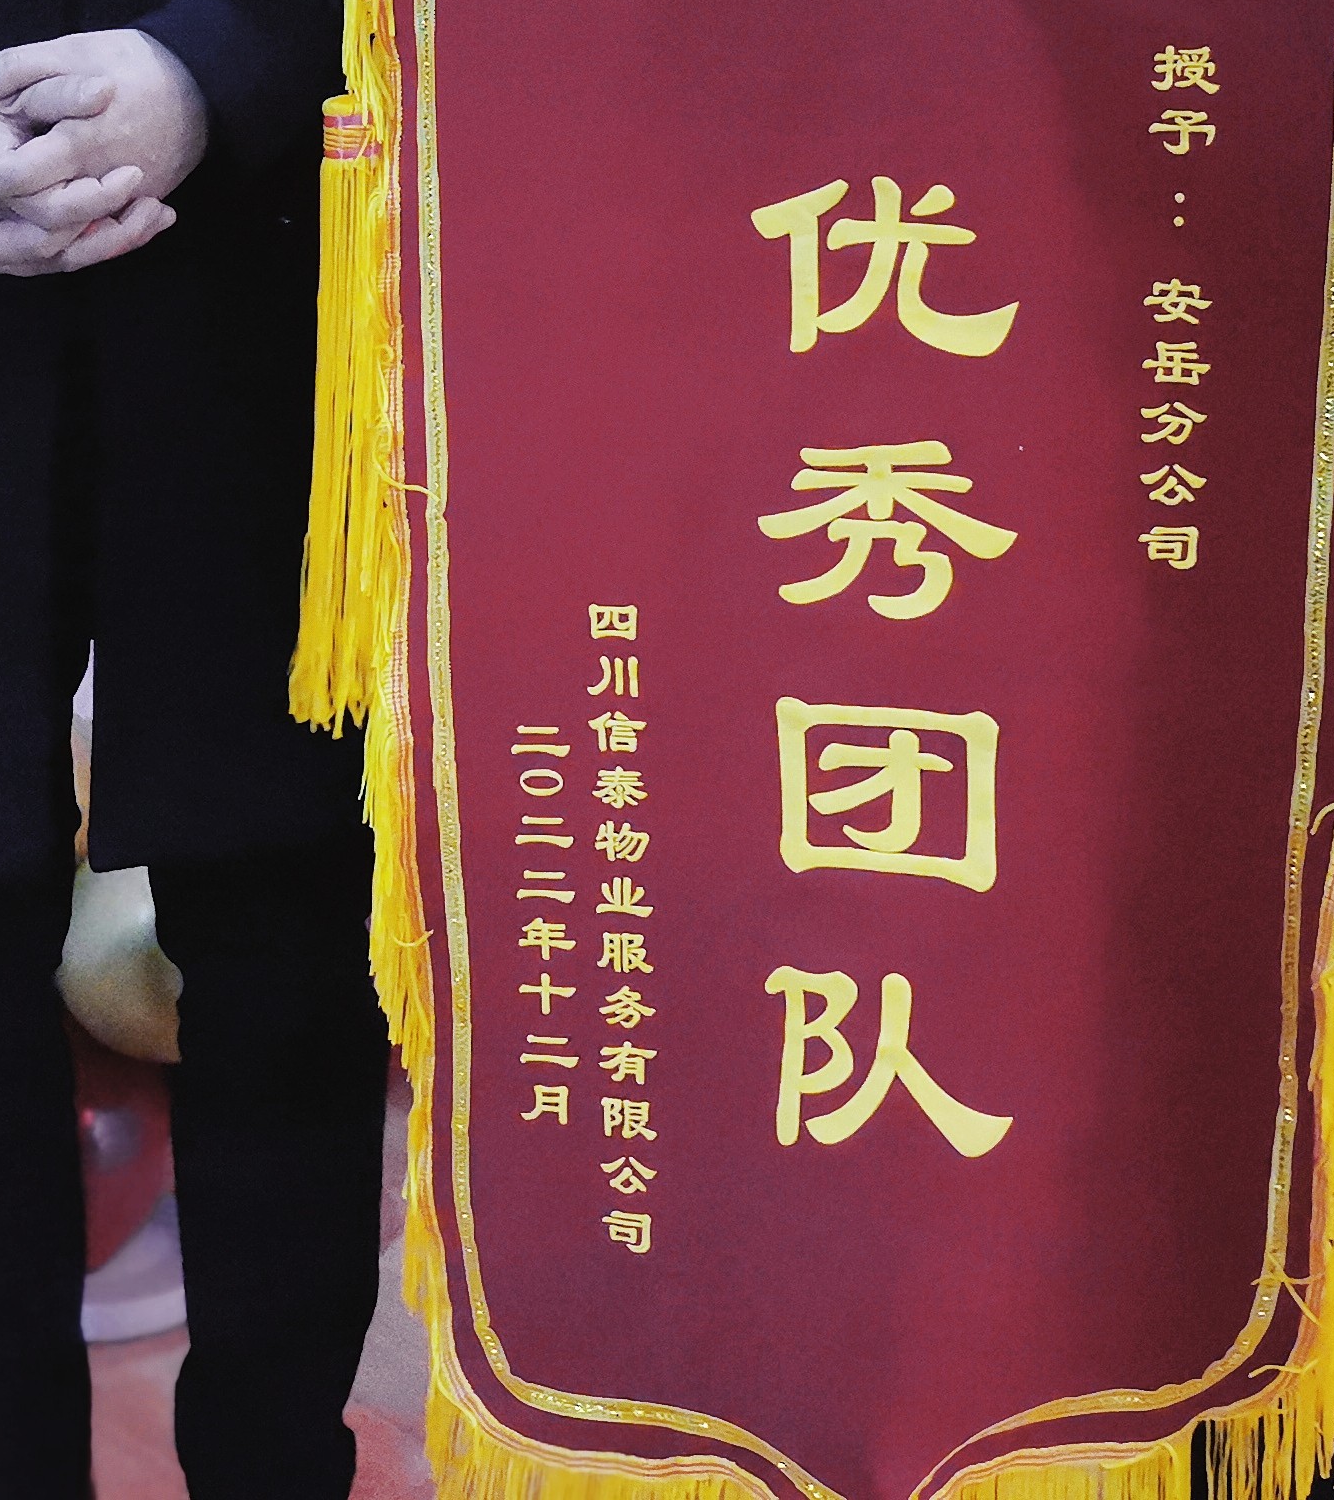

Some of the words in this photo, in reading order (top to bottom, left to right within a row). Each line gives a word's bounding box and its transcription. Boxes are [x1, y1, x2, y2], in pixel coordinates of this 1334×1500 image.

[586, 603, 658, 1255] 四川信泰物业服务有限公司
[751, 175, 1018, 1158] 优秀团队
